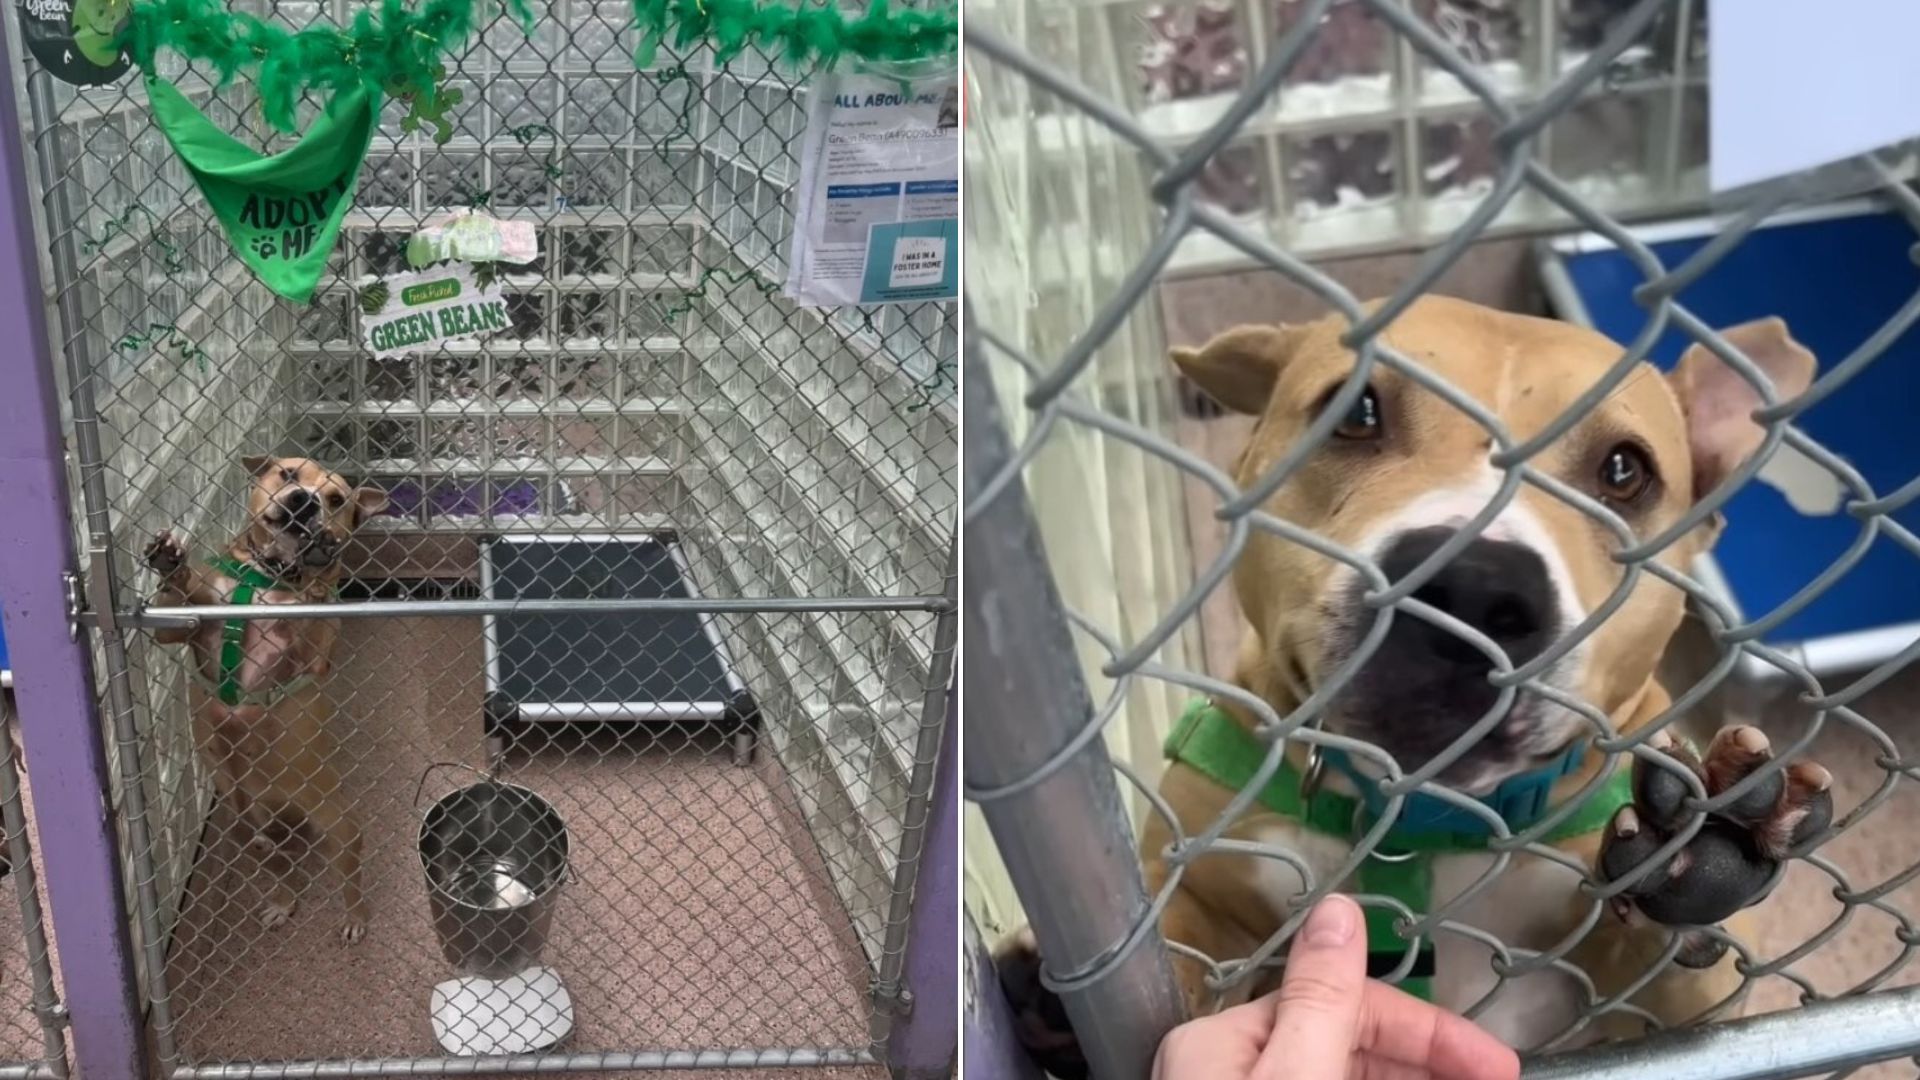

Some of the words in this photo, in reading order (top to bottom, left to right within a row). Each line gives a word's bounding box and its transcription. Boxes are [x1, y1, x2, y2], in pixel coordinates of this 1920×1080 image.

[834, 94, 860, 108] ALL
[906, 252, 920, 260] WAS
[894, 262, 920, 271] FOSTER
[921, 260, 941, 269] HOME
[371, 310, 437, 352] GREEN
[437, 301, 506, 337] BEANS
